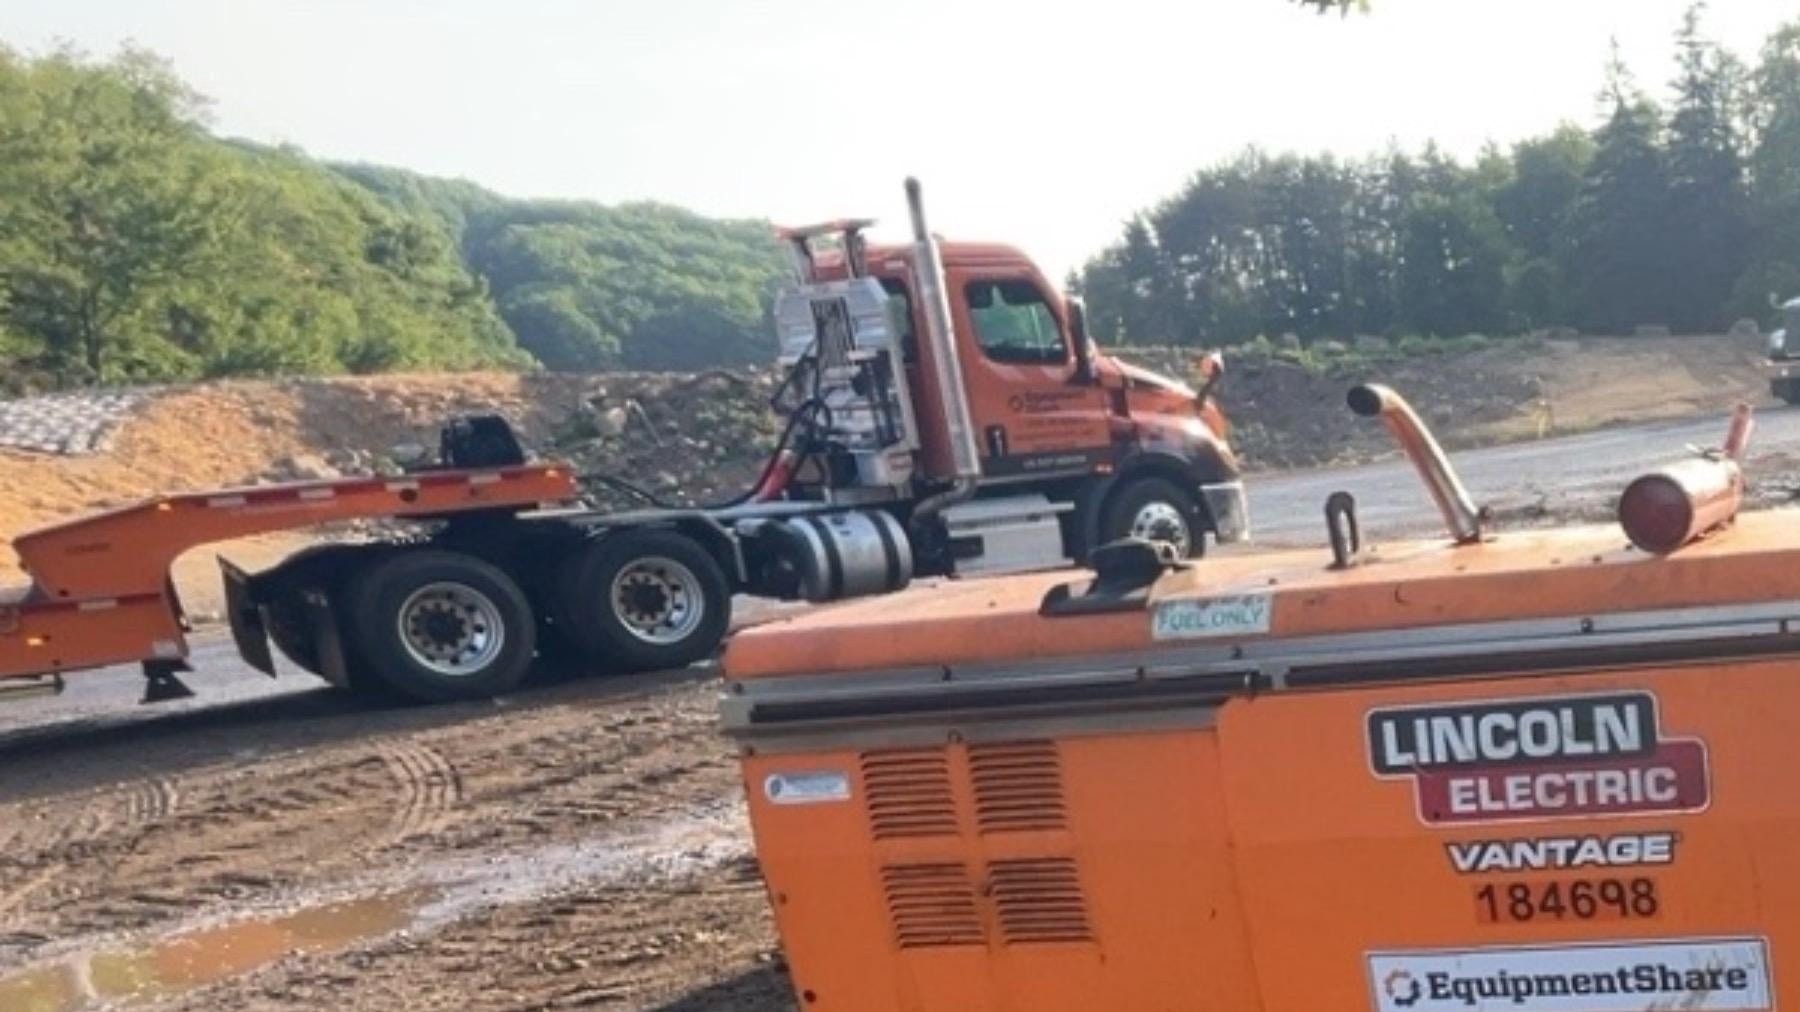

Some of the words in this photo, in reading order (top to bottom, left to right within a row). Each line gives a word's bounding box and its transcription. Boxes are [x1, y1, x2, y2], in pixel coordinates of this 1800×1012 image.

[1211, 605, 1263, 628] ONLY
[1381, 703, 1642, 767] LINCOLN
[1448, 767, 1679, 815] ELECTRIC
[1445, 834, 1675, 872] VANTAGE
[1477, 878, 1658, 923] 184698
[1428, 962, 1749, 1009] EquipmentShare
